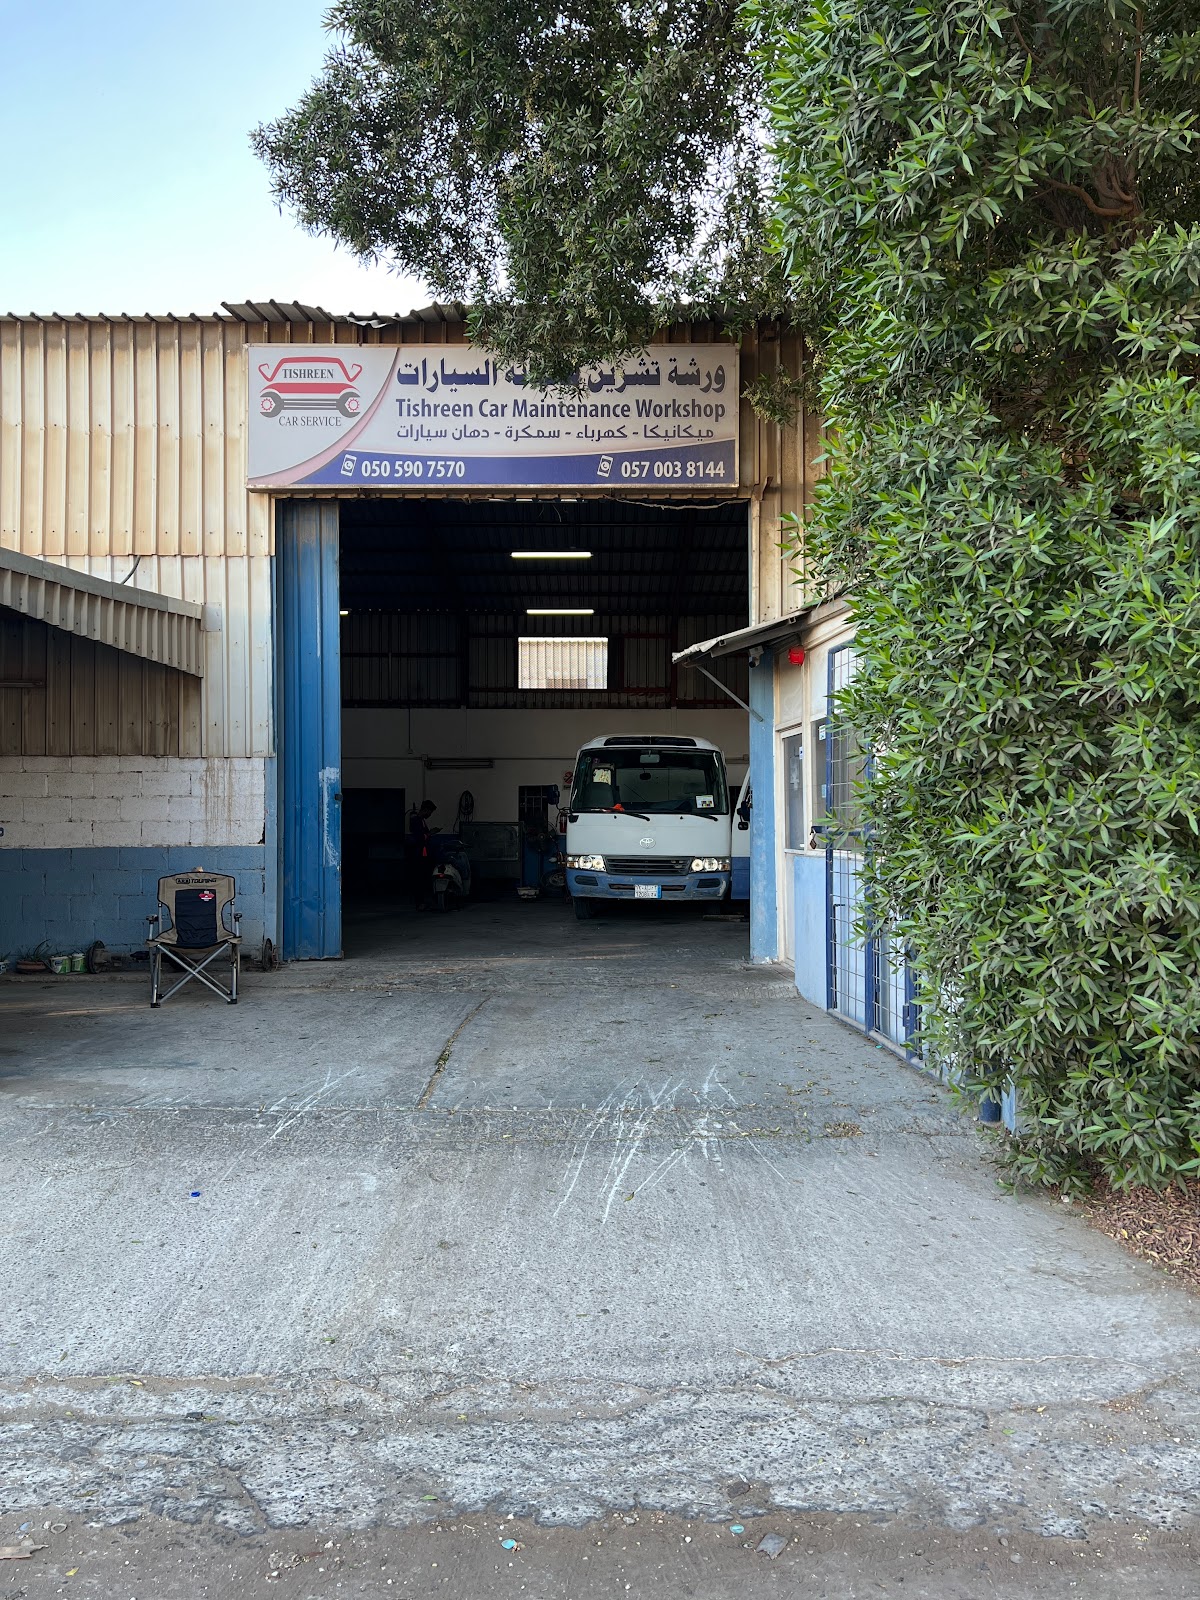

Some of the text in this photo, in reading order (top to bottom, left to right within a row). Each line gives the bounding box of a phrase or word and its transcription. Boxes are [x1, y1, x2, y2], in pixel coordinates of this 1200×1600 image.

[282, 368, 334, 379] TISHREEN
[396, 357, 498, 393] السيارات
[667, 357, 726, 393] ورشة
[395, 398, 726, 422] Tishreen Car Maintenance Workshop
[278, 416, 342, 427] CAR SERVICE
[397, 424, 447, 442] سيارات
[451, 424, 490, 441] دهان
[505, 425, 560, 442] سمكرة
[575, 424, 628, 442] كهرباء
[643, 424, 714, 442] ميكانيكا
[361, 460, 465, 477] 050 590 7570
[621, 461, 726, 478] 057 003 8144
